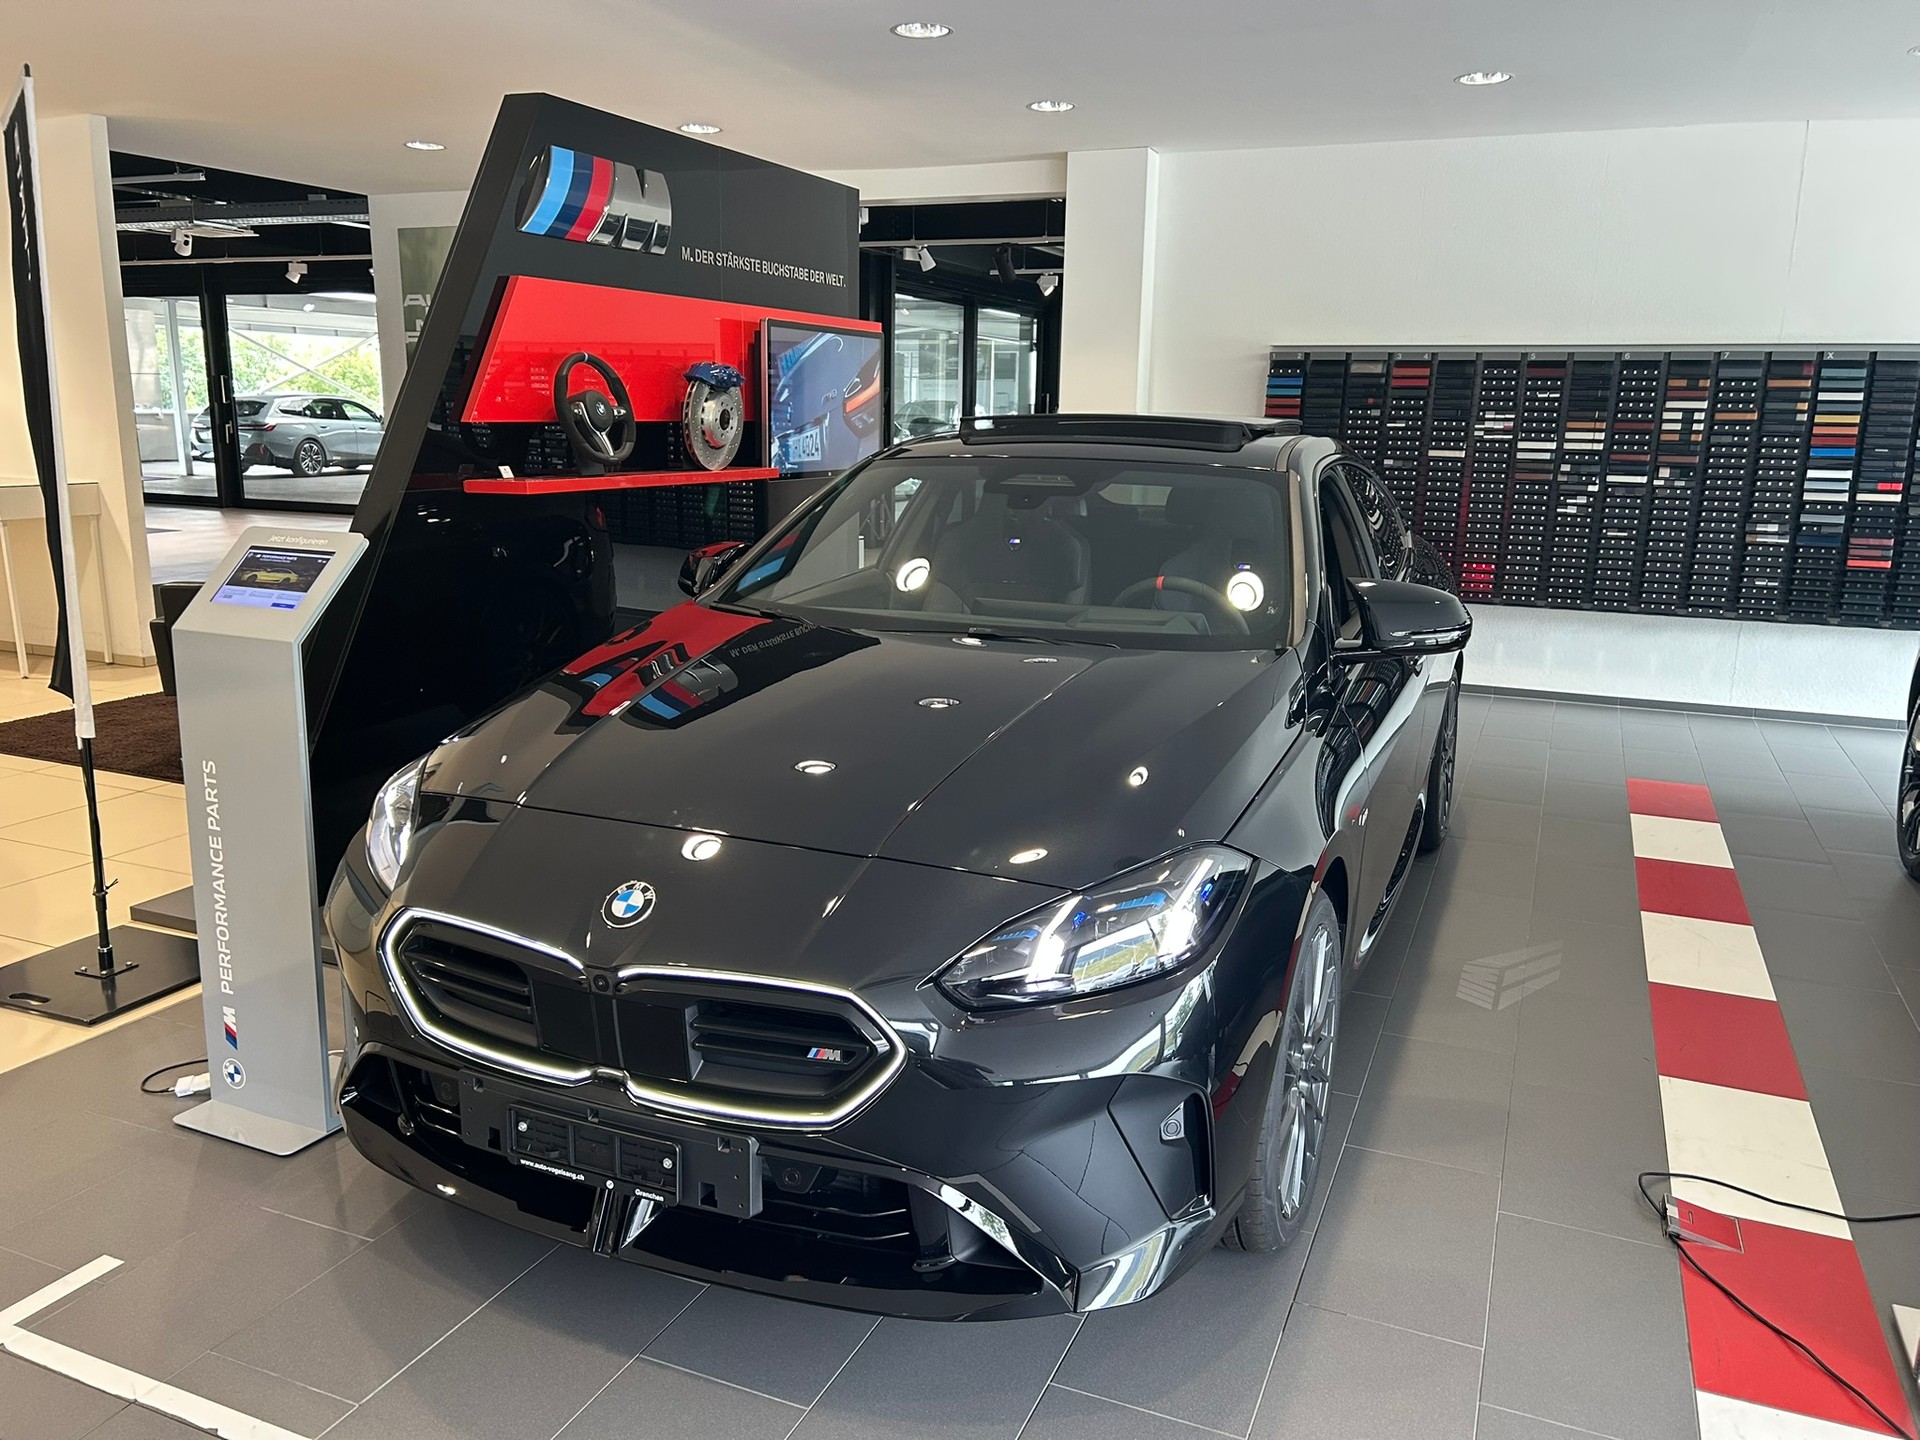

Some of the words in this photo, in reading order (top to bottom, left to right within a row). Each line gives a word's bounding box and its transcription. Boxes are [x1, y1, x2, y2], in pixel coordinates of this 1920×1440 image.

[681, 246, 694, 262] M.
[695, 248, 714, 265] DER
[715, 251, 761, 273] STÄRKSTE
[761, 260, 809, 281] BUCHSTABE
[809, 269, 825, 284] DER
[825, 272, 846, 288] WELT.
[202, 760, 222, 832] PARTS
[208, 834, 235, 996] PERFORMANCE
